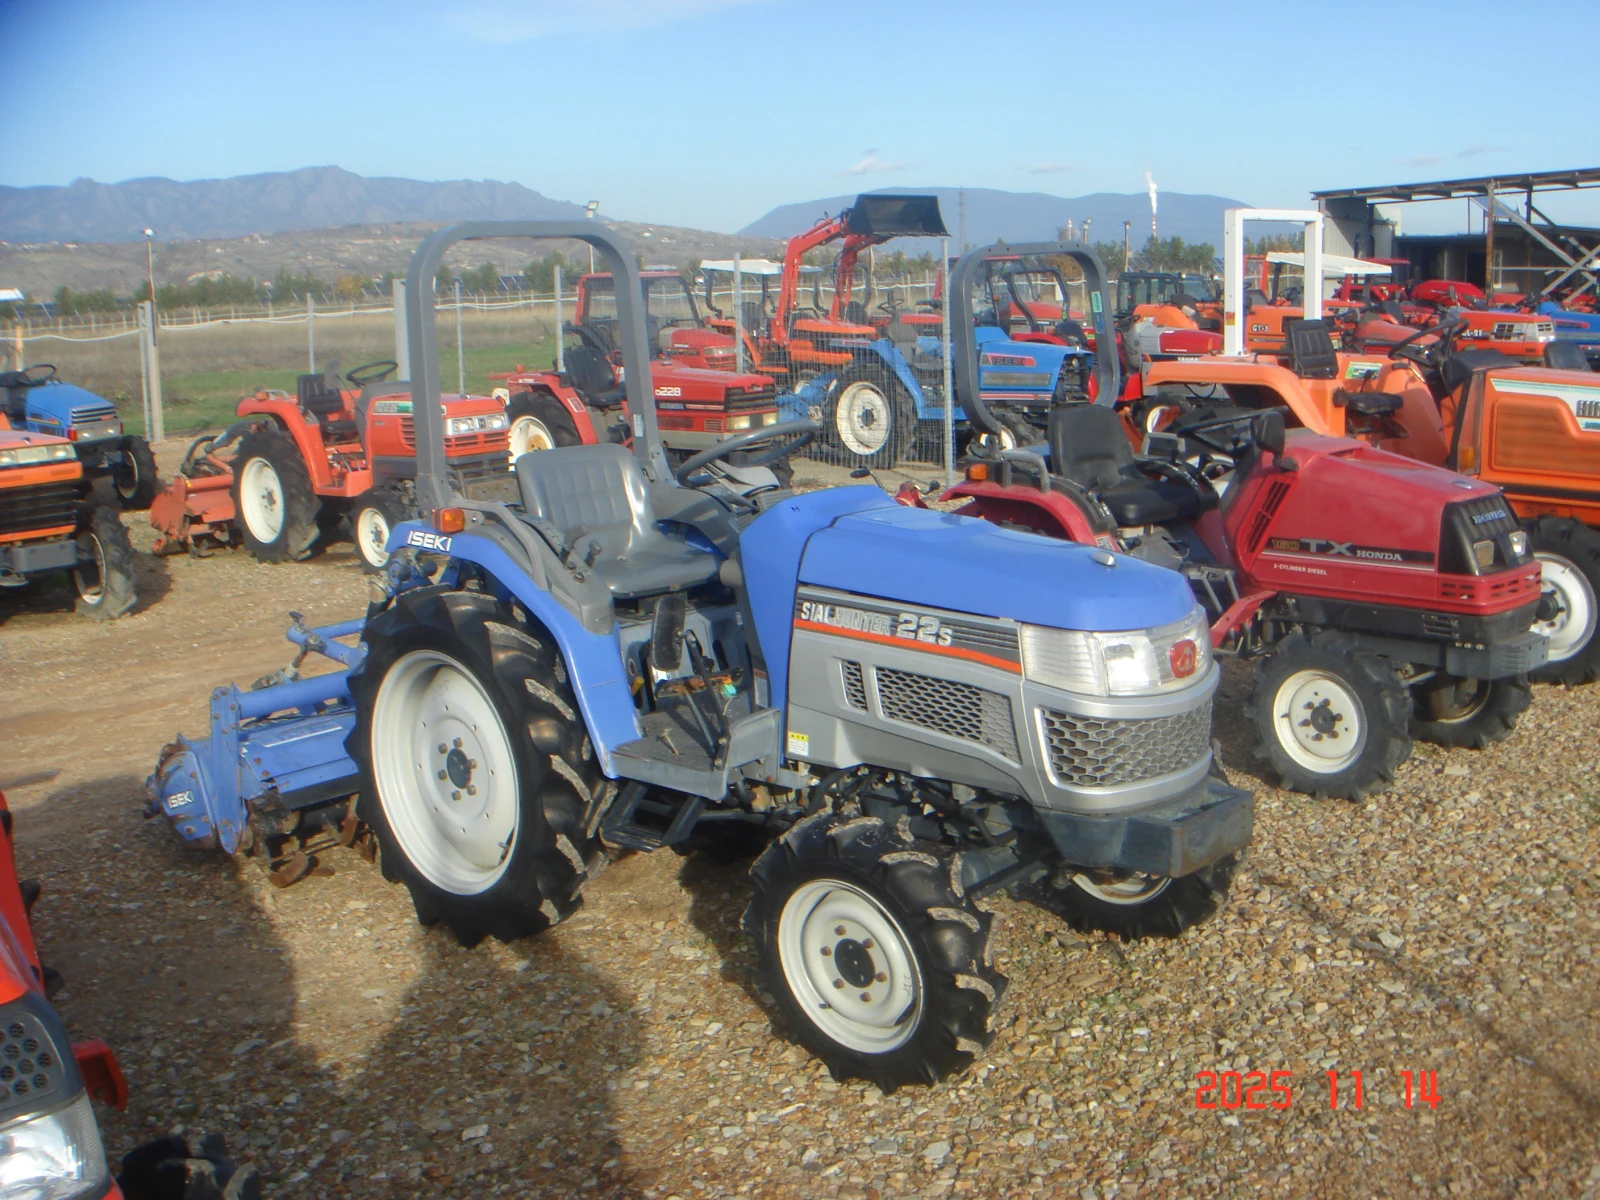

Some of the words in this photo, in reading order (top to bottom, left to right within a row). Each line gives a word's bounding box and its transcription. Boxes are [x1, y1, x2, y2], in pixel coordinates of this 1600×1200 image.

[407, 530, 453, 552] ISEKI
[1300, 537, 1354, 557] TX
[1355, 549, 1403, 562] HONDA
[1307, 568, 1328, 576] DIESEL
[167, 790, 194, 809] ISEKI
